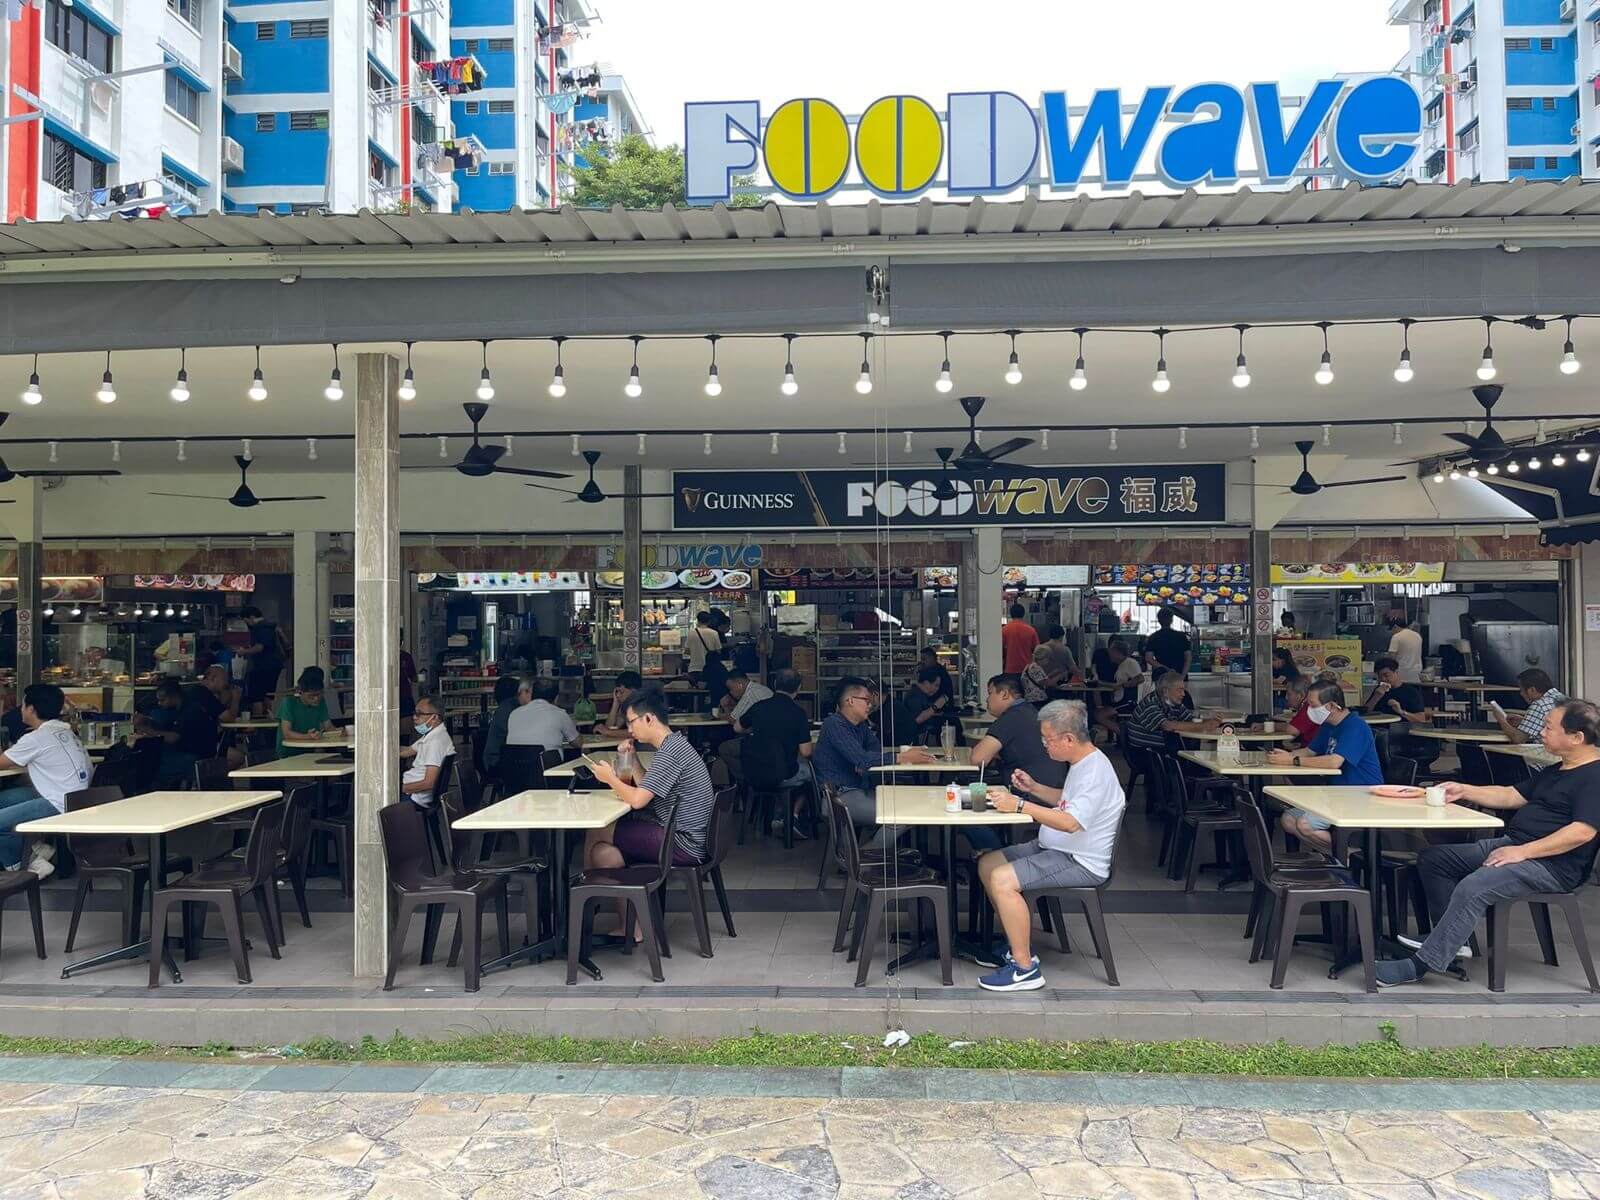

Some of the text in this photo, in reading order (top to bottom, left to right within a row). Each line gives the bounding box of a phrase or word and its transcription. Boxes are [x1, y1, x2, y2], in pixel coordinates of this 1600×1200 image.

[684, 74, 1423, 202] FOODwave
[703, 491, 794, 510] GUINNESS
[1119, 476, 1198, 514] 福威
